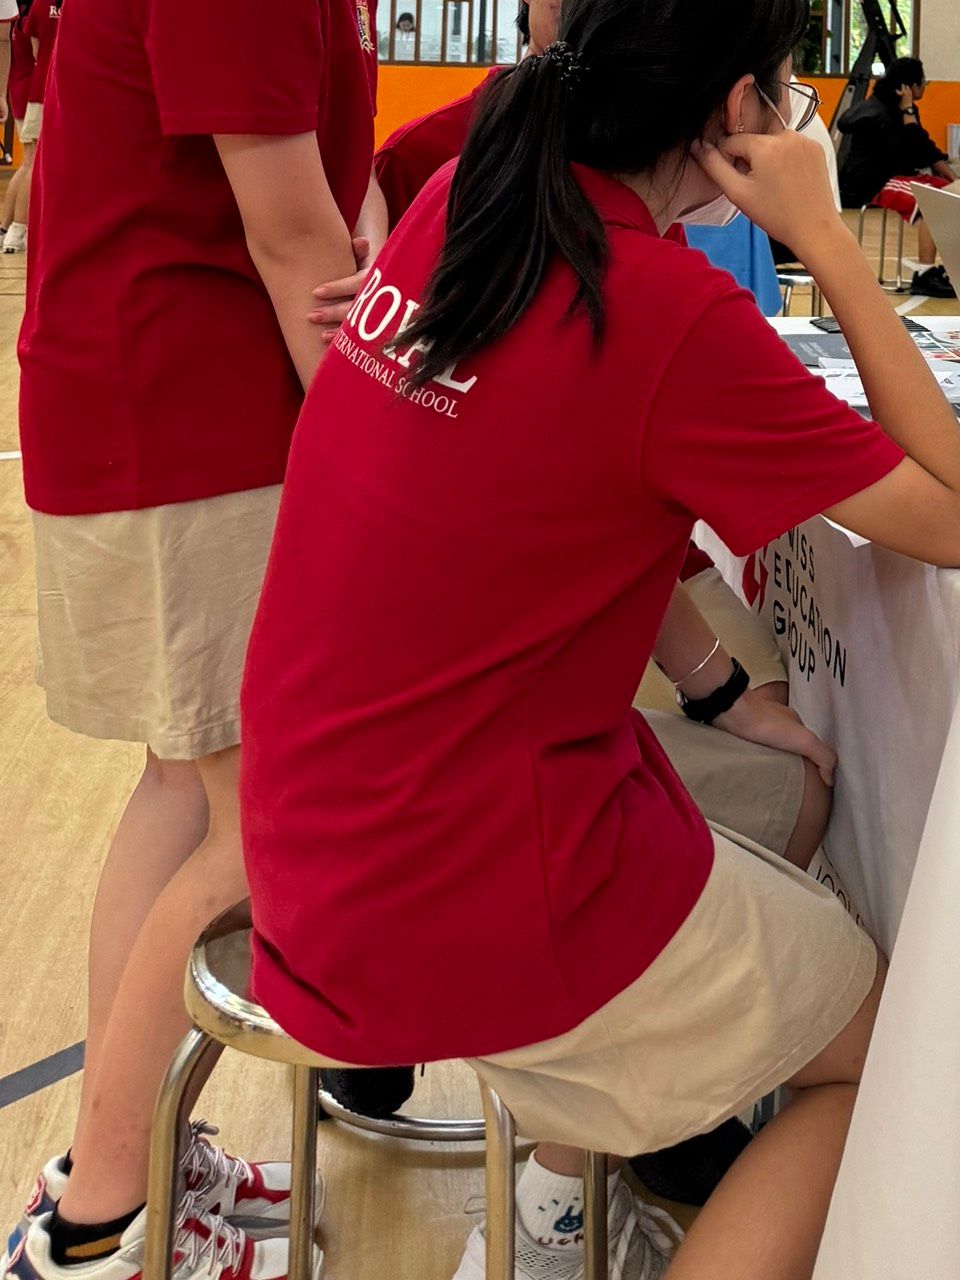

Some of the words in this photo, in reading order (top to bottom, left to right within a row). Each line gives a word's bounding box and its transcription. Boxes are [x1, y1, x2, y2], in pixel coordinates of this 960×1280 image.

[332, 329, 395, 388] NTERNATIONAL
[395, 377, 458, 418] SCHOOL
[777, 526, 815, 583] ISS
[773, 600, 816, 682] GOUP
[774, 550, 847, 687] EDUCATION
